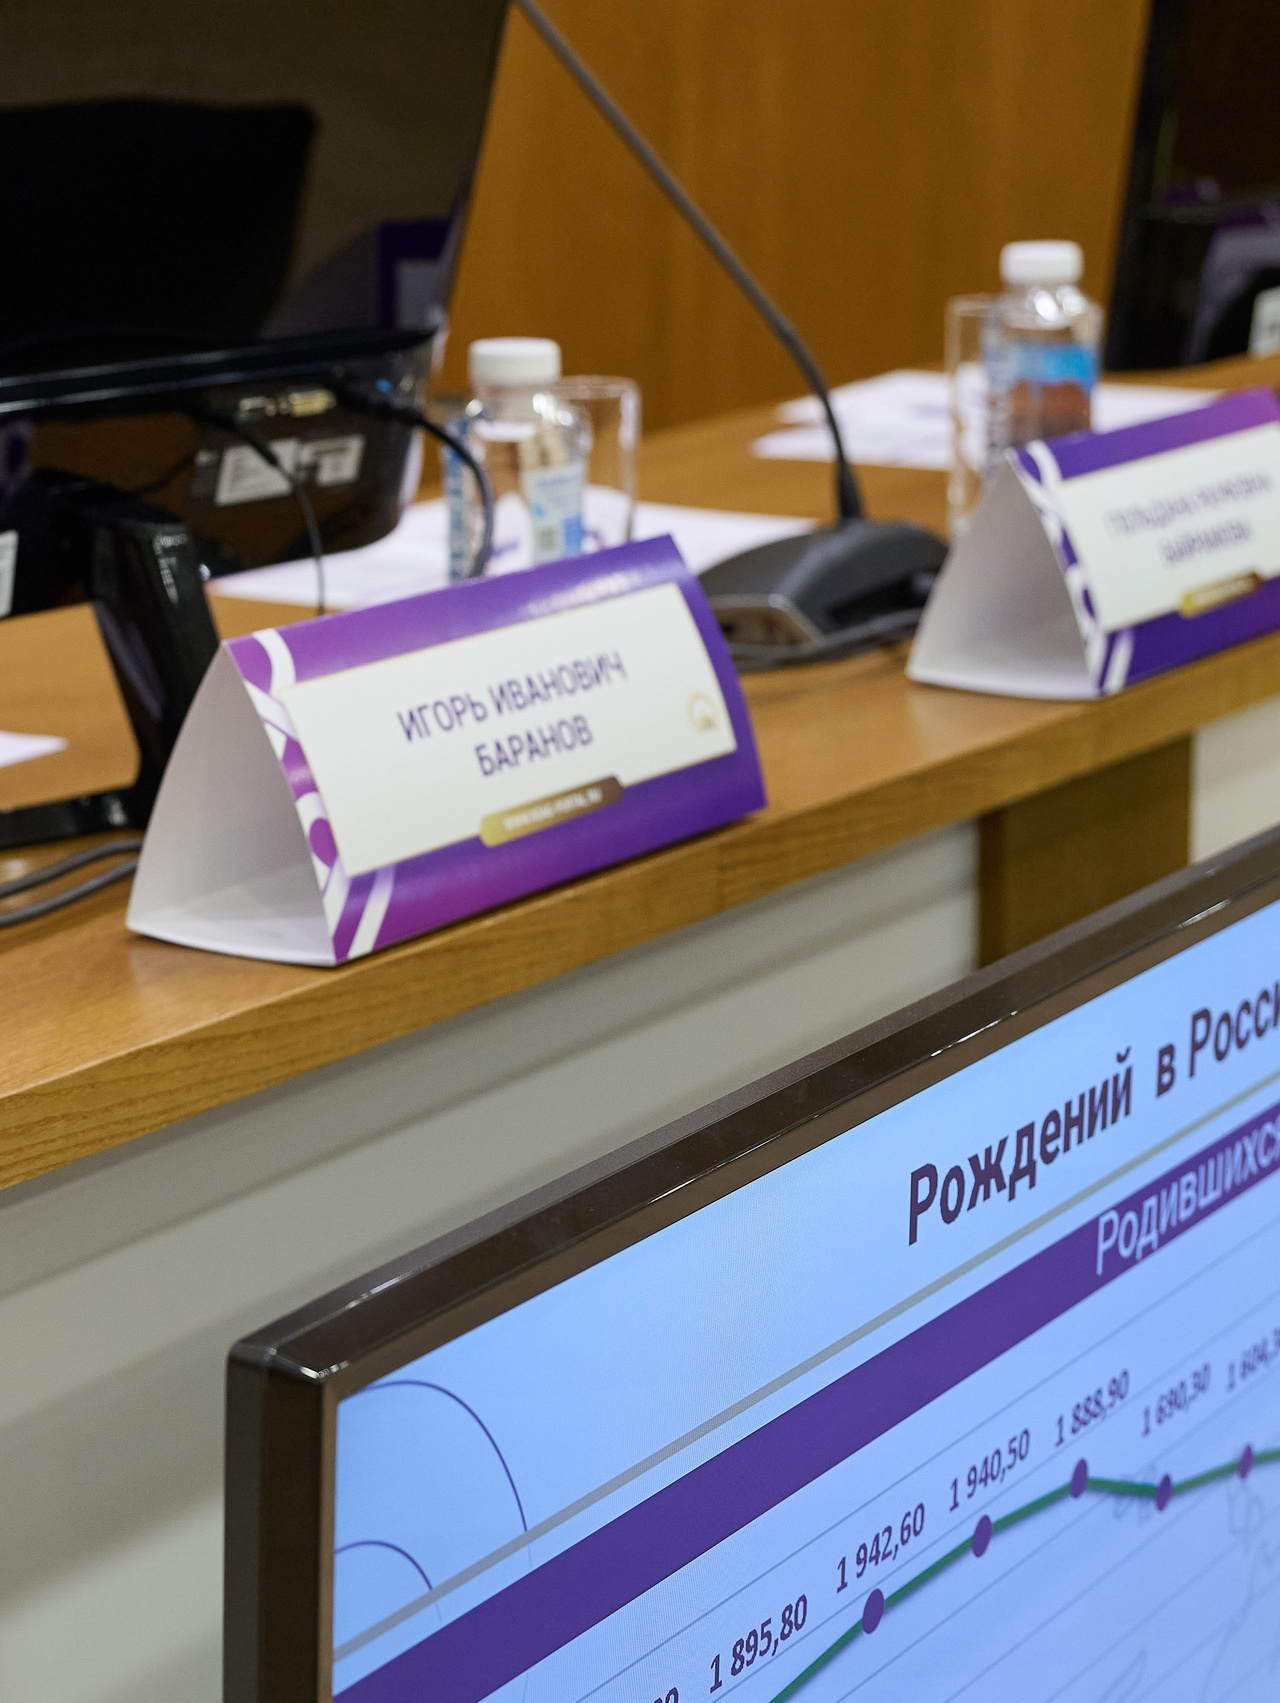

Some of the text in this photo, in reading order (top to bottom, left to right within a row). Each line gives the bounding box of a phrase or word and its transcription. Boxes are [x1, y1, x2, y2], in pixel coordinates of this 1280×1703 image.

[397, 651, 629, 743] ИГОРЬ ИВАНОВИЧ
[474, 715, 594, 778] БАРАНОВ
[908, 1046, 1134, 1247] Рождений
[1156, 1043, 1176, 1098] в
